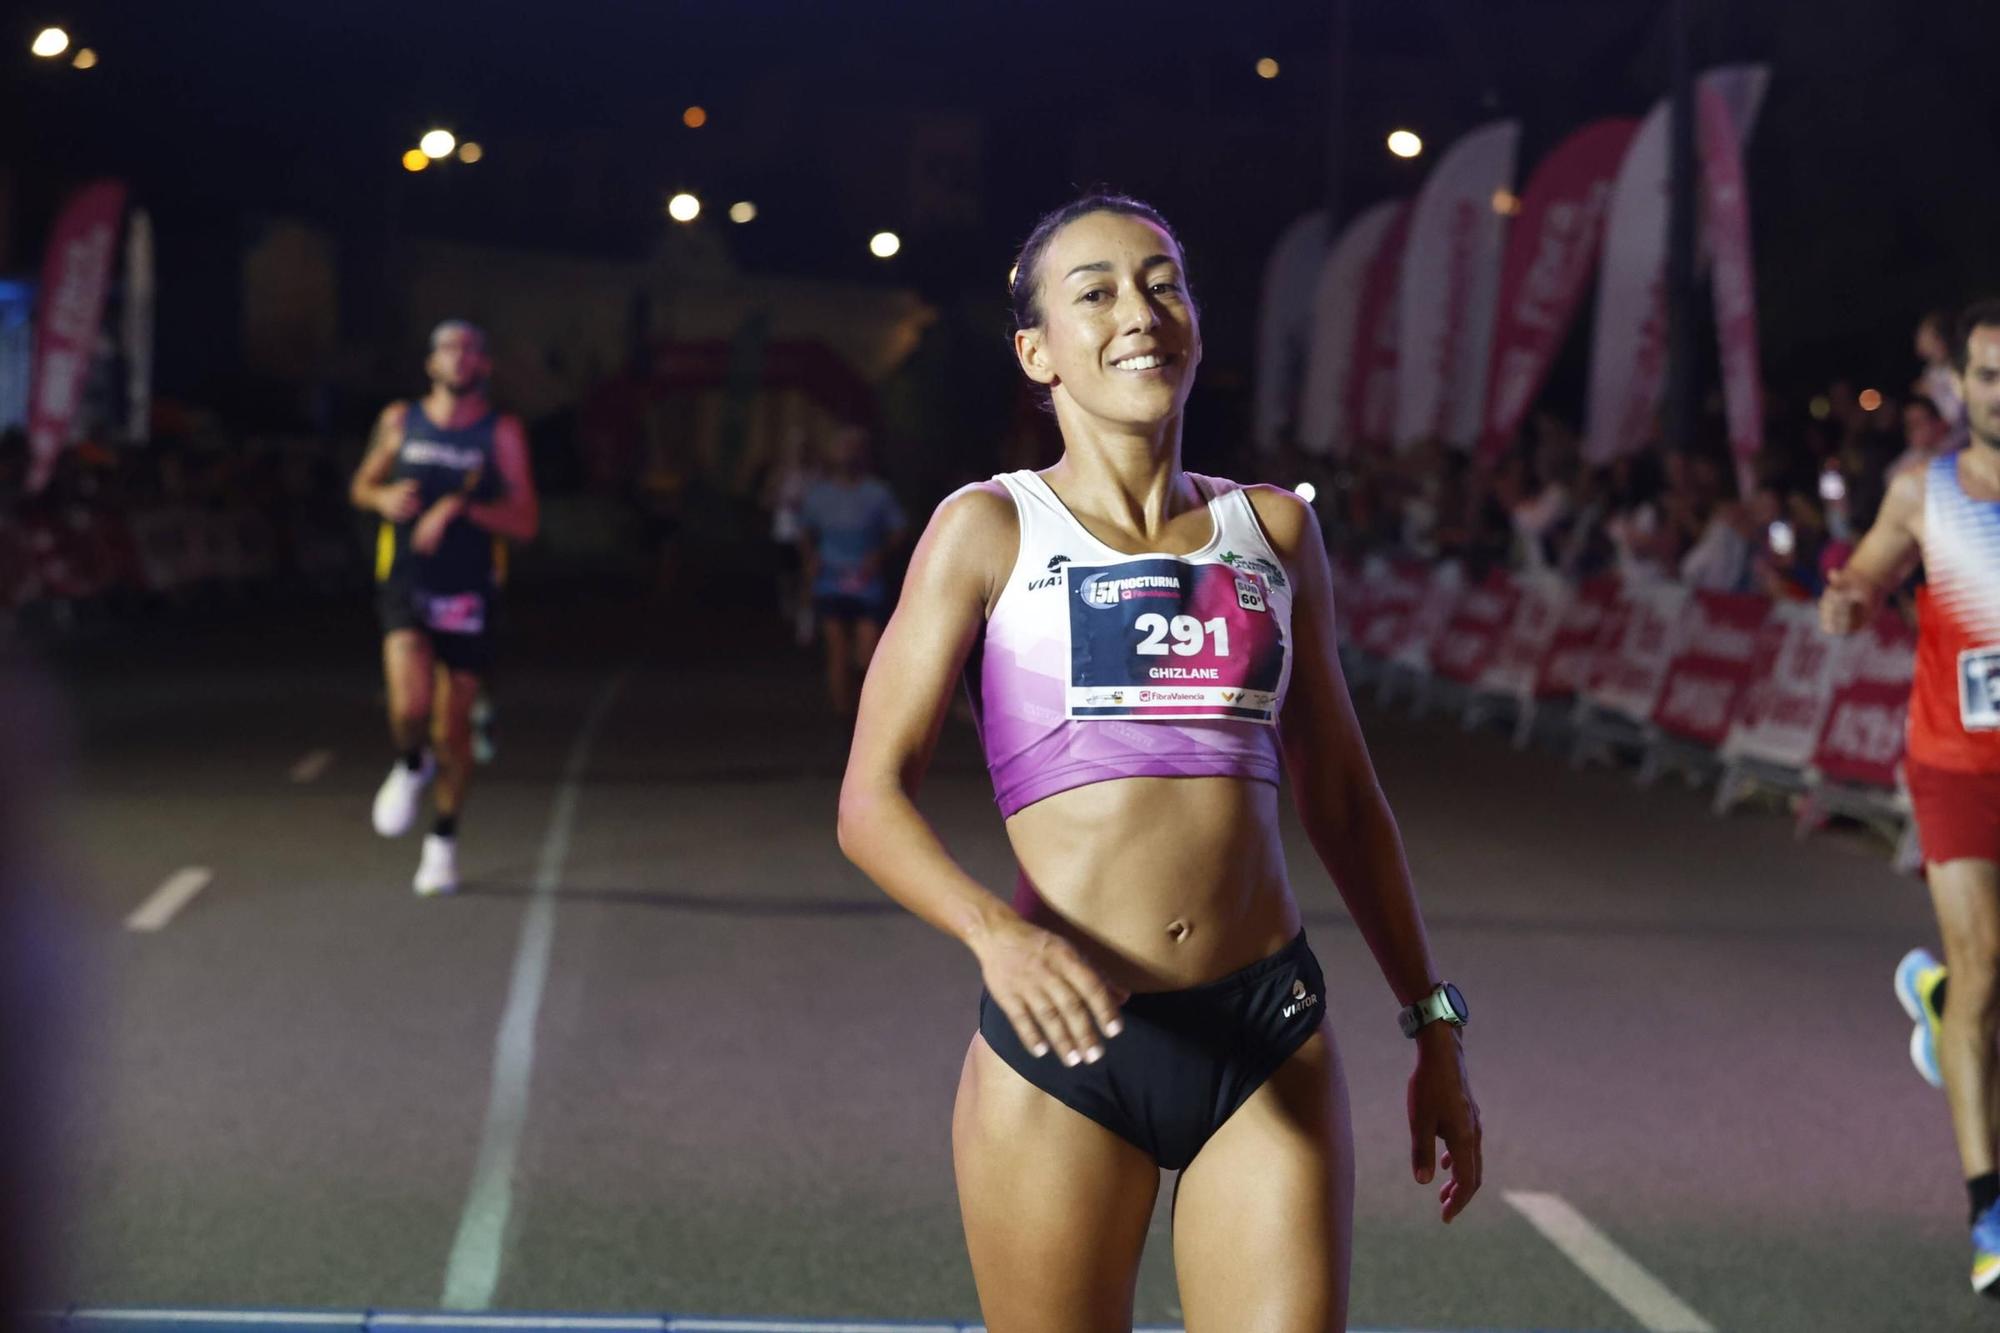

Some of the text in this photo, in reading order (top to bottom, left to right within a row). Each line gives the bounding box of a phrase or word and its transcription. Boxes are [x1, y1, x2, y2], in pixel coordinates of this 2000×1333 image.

[1089, 580, 1121, 604] 15K
[1120, 576, 1180, 590] NOCTURNA
[1238, 582, 1258, 594] SUB
[1135, 612, 1229, 657] 291
[1149, 667, 1219, 680] GHIZLANE
[1151, 692, 1205, 701] FibraValencia
[1283, 994, 1318, 1018] VIATOR
